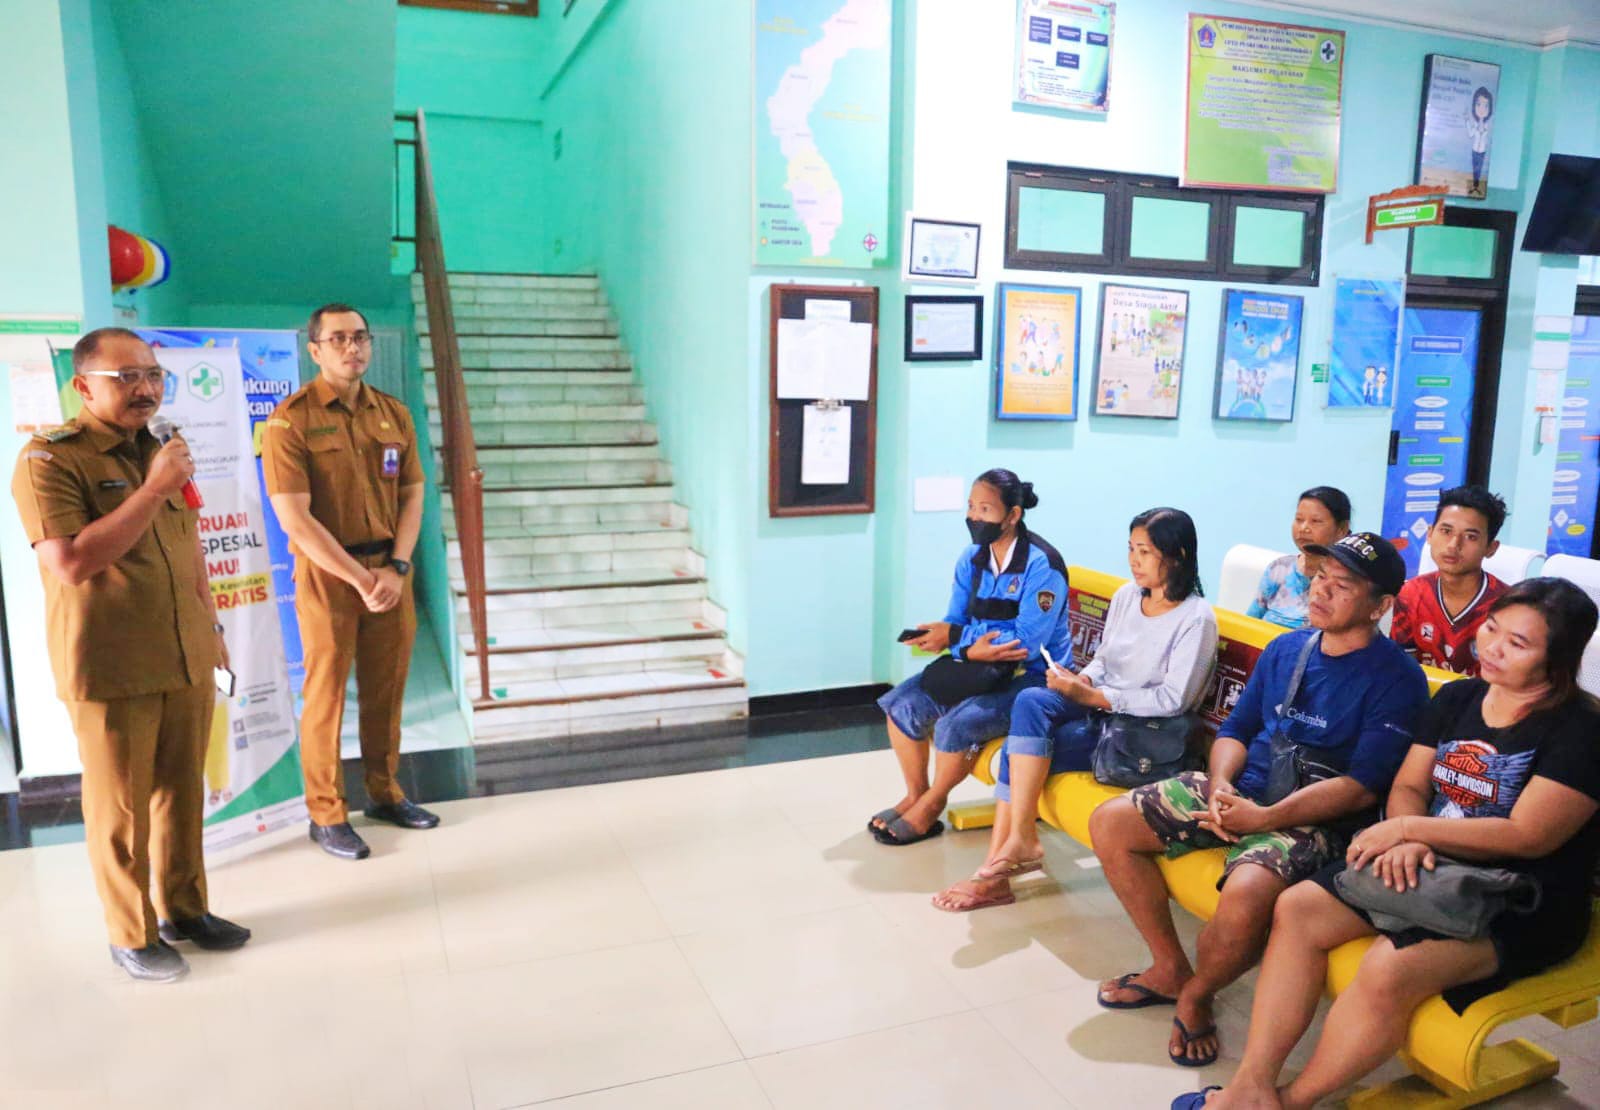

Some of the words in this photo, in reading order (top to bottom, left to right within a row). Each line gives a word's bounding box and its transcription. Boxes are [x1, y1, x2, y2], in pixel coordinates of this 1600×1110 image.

[1135, 300, 1157, 311] Siaga
[247, 399, 275, 416] kan
[198, 512, 248, 533] RUARI
[207, 558, 240, 578] MU!
[214, 586, 268, 609] RATIS
[1286, 707, 1328, 729] Columbia
[1448, 755, 1481, 774] MOTOR
[1432, 763, 1495, 799] HARLEY-DAVIDSON
